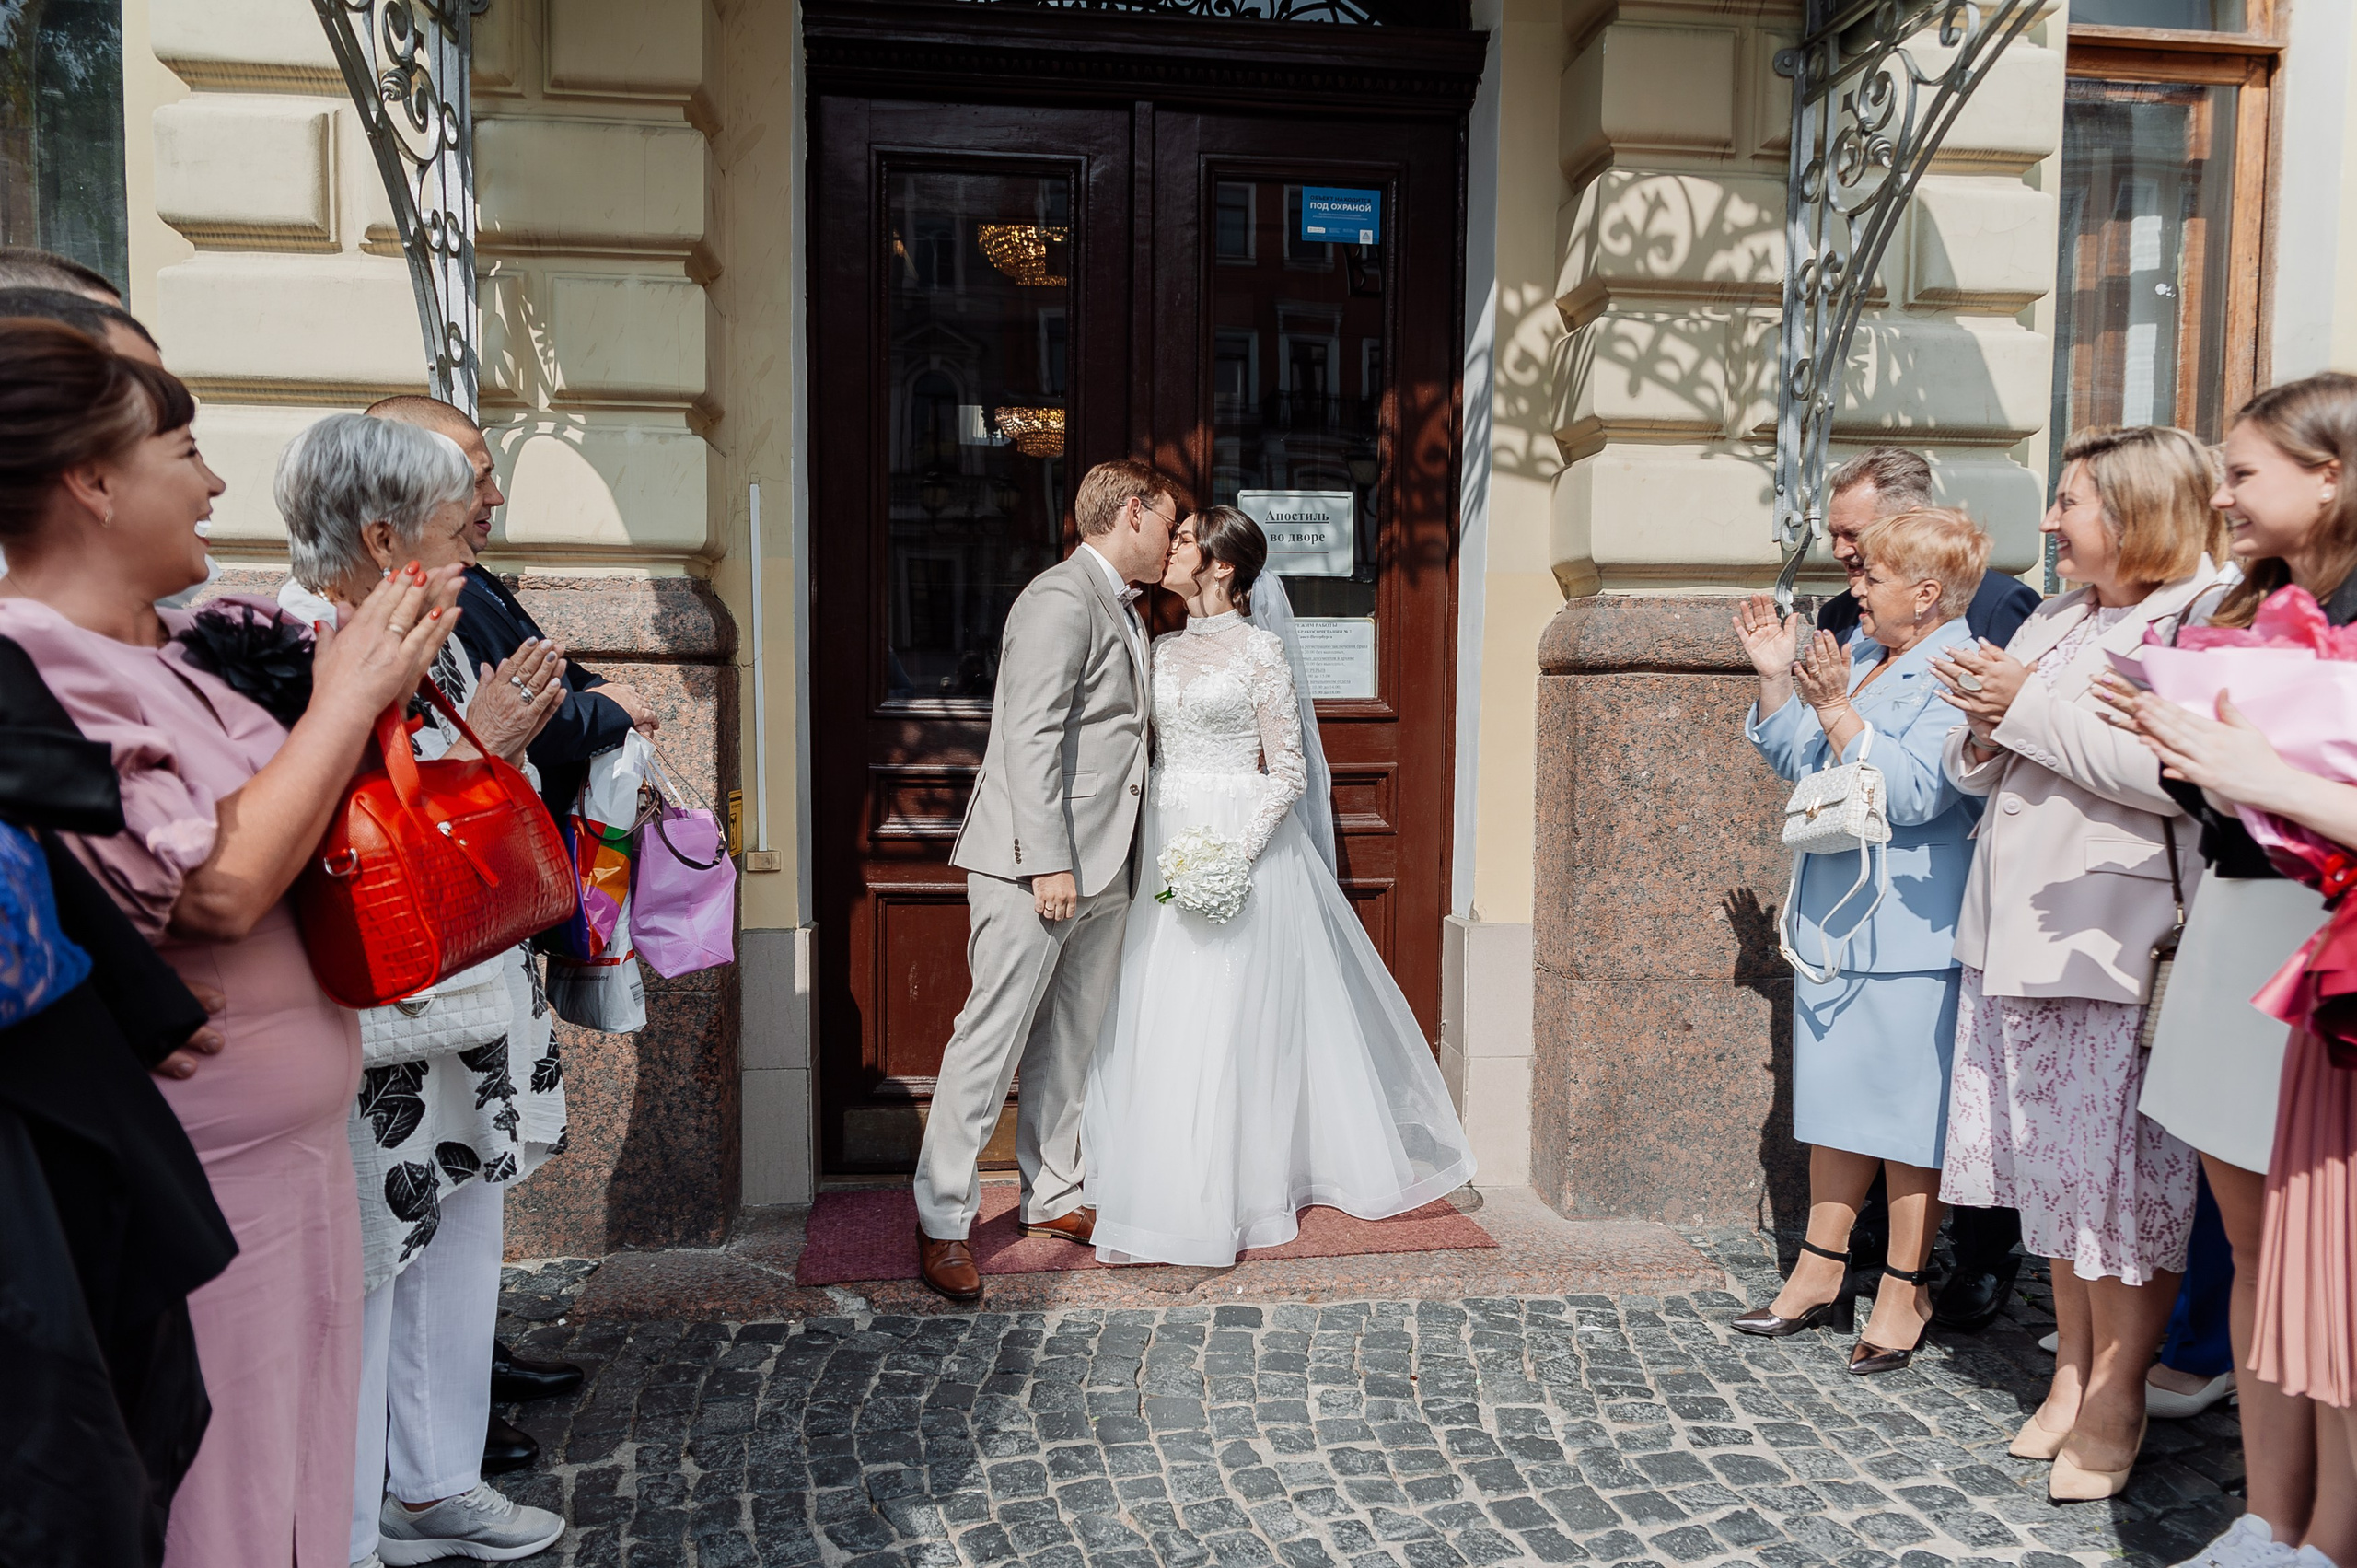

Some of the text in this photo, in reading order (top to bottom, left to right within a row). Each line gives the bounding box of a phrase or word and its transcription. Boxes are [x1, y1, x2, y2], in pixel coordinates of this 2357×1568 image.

[1310, 202, 1372, 213] ПОД ОХРАНОЙ
[1265, 510, 1329, 521] Апостиль
[1270, 533, 1326, 544] во дворе
